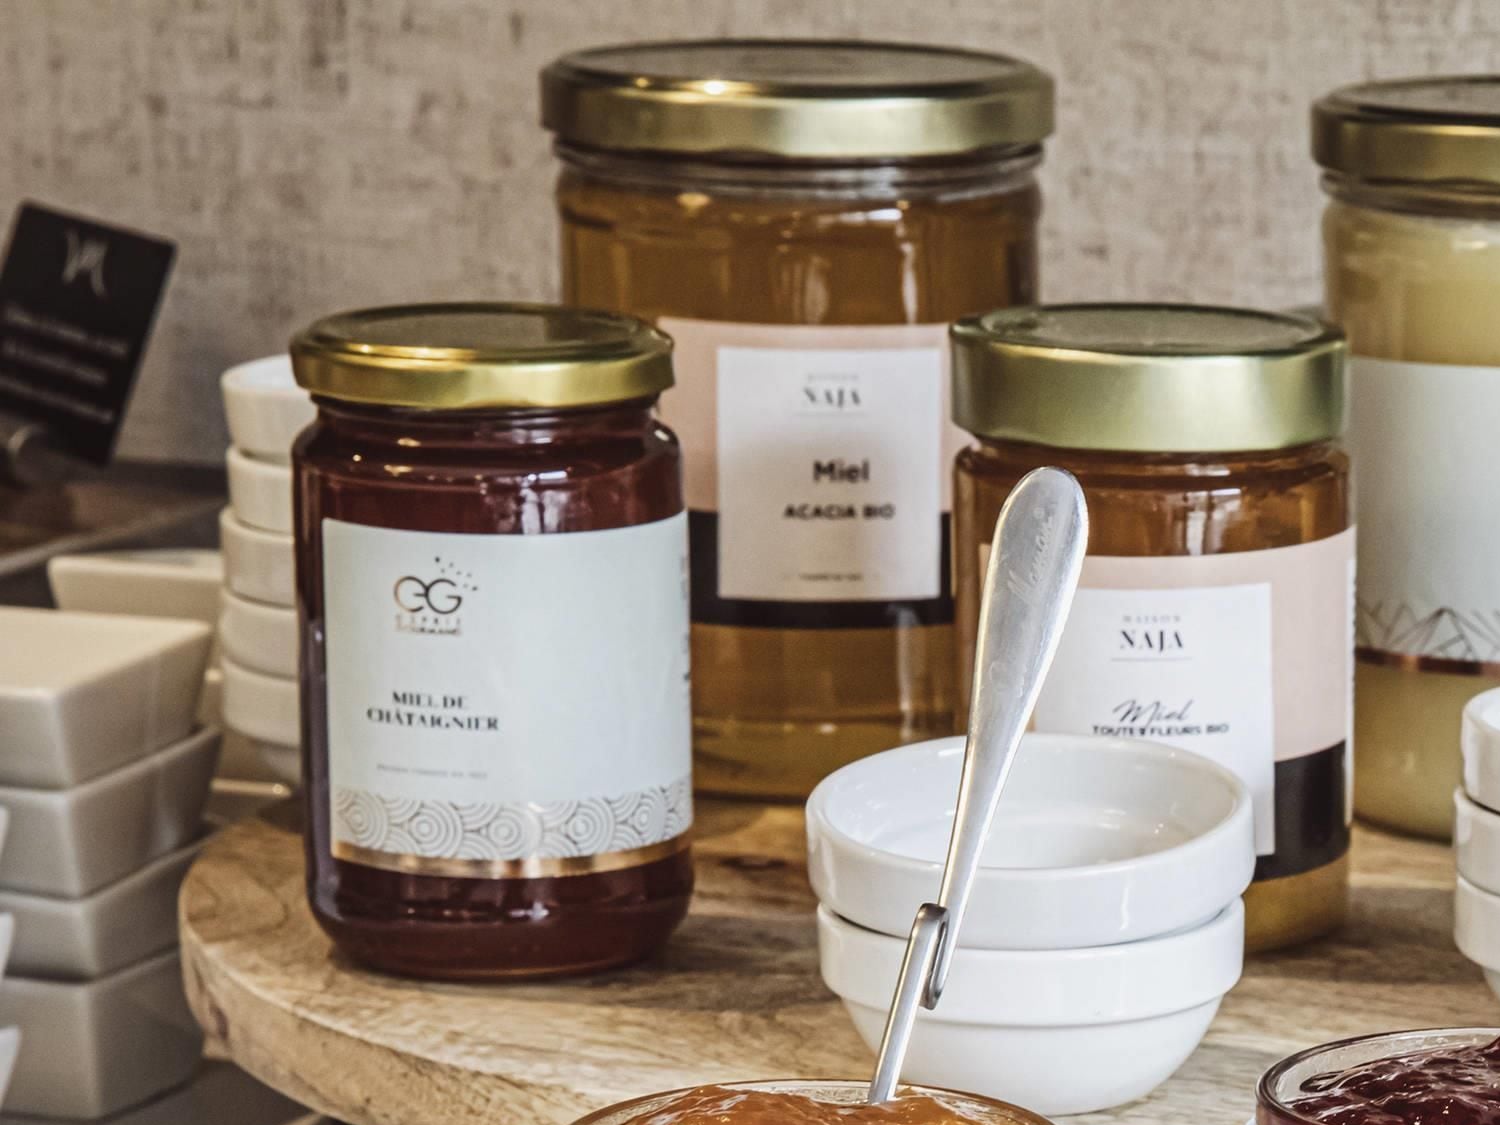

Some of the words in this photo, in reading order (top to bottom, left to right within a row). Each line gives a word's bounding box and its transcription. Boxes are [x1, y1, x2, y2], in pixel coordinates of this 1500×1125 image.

[812, 460, 870, 484] Miel
[784, 503, 857, 520] ACACIA
[862, 503, 896, 520] BIO
[1119, 629, 1184, 652] NAJA
[1112, 698, 1194, 727] Miel
[1206, 723, 1230, 734] BIO
